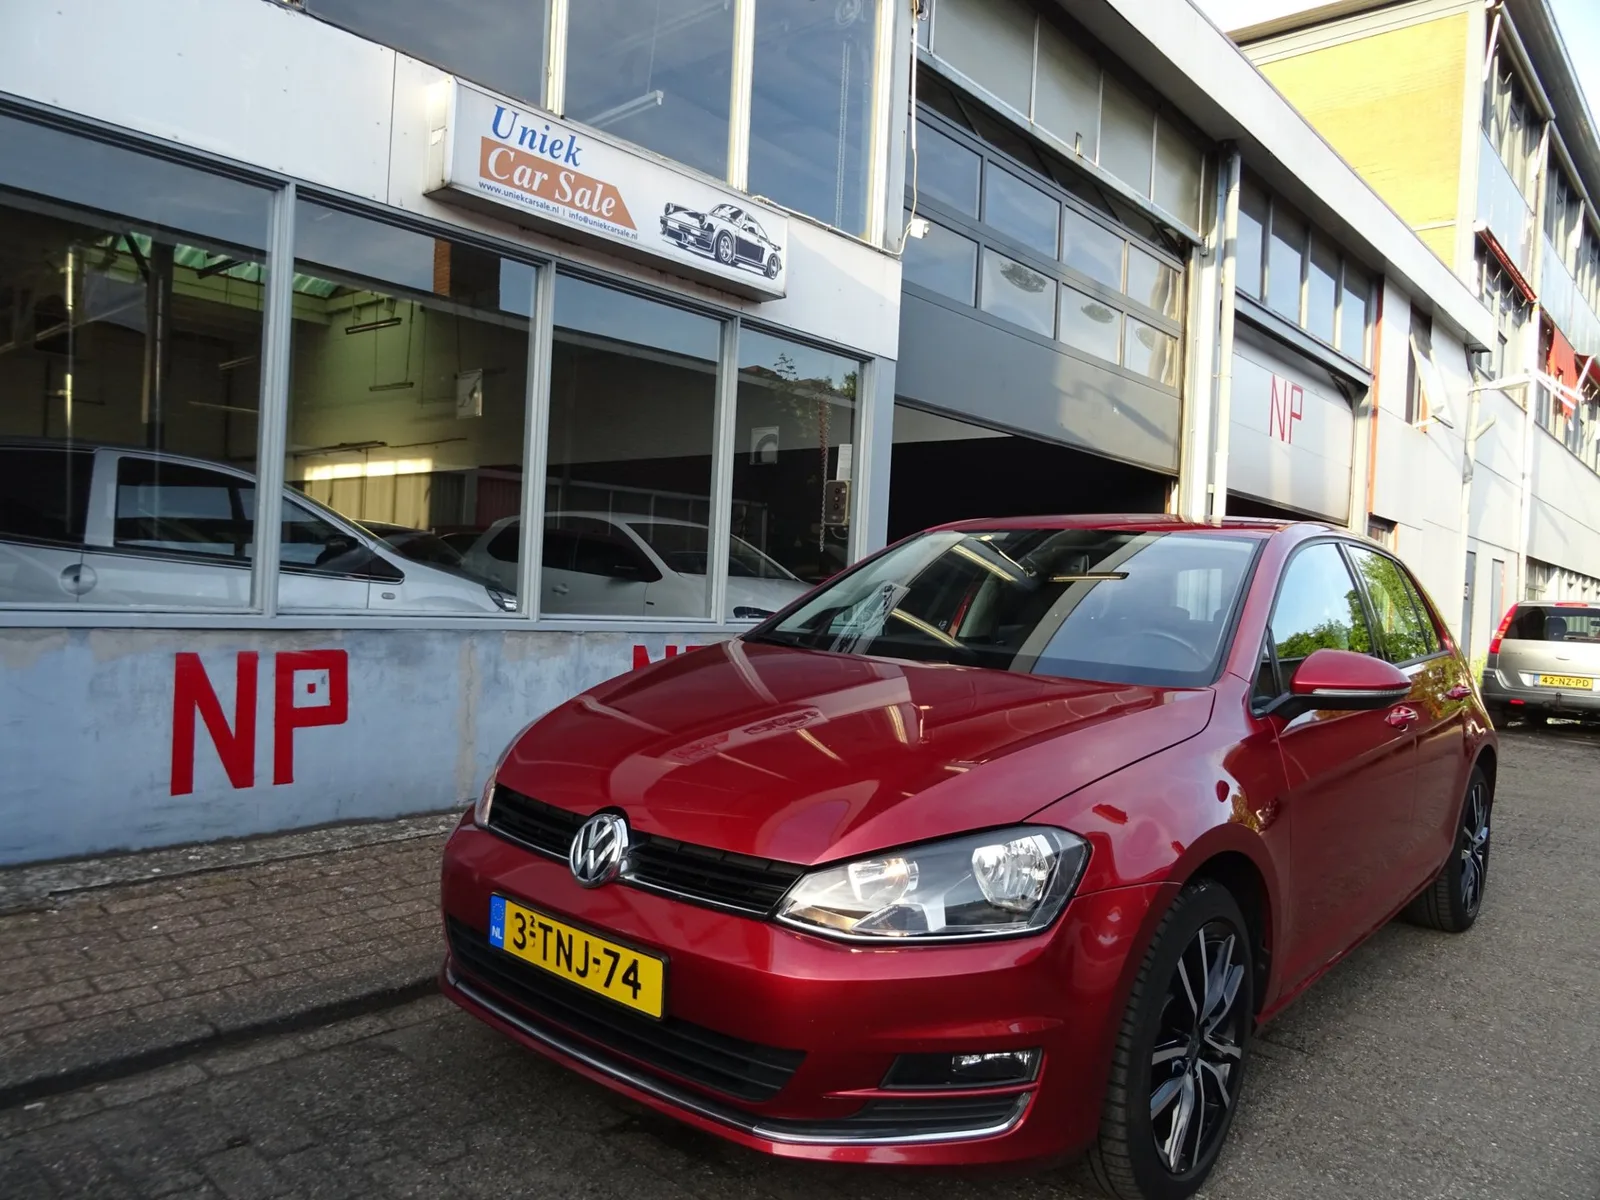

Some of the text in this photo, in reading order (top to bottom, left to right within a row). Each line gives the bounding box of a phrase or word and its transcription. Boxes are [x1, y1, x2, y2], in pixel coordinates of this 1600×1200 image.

[491, 104, 583, 167] Uniek
[478, 181, 560, 214] www.uniekcarsale.nl
[568, 211, 638, 240] info@uniekcarsale.nl
[487, 147, 616, 217] Car Sale
[1269, 372, 1304, 445] NP
[1542, 676, 1589, 687] 42-NZ-PD
[170, 648, 349, 797] NP
[491, 925, 503, 940] NL
